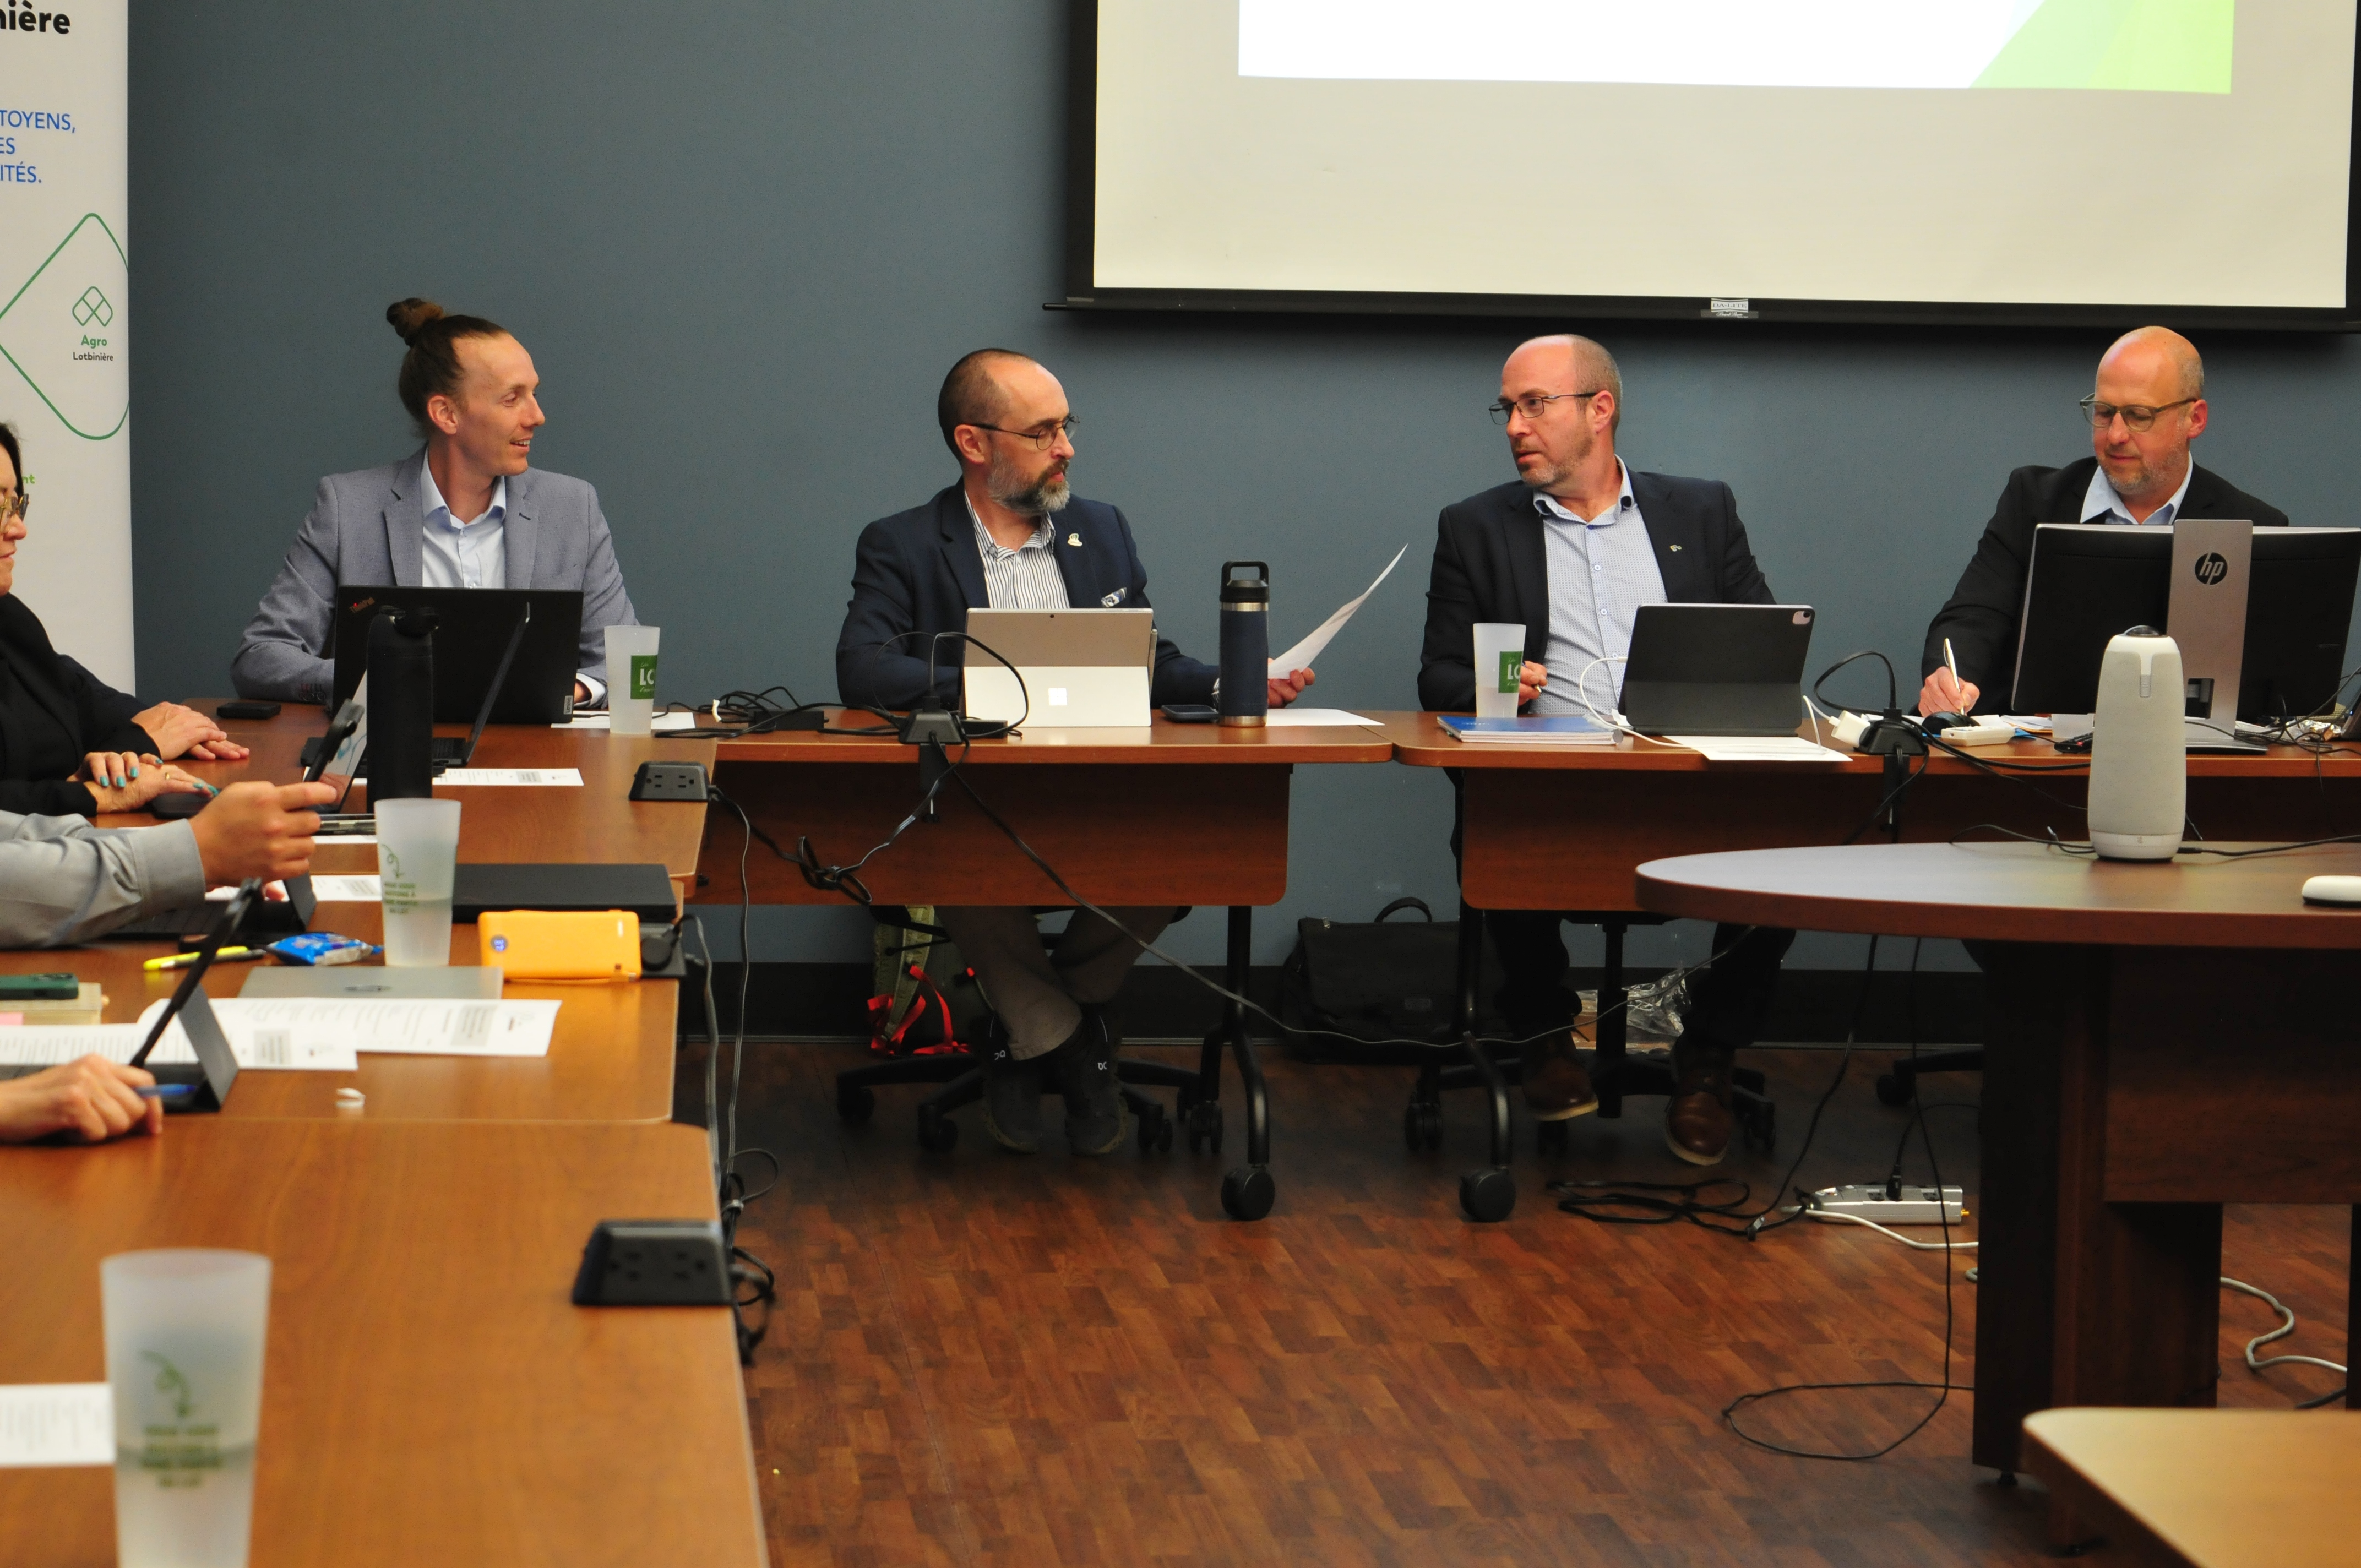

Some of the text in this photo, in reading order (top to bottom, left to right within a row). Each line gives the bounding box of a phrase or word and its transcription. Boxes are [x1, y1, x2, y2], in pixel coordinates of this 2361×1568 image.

[0, 110, 75, 133] TOYENS,
[1, 161, 42, 183] ITÉS.
[80, 334, 107, 349] Agro
[73, 351, 113, 361] Lotbinière
[2198, 552, 2224, 585] hp
